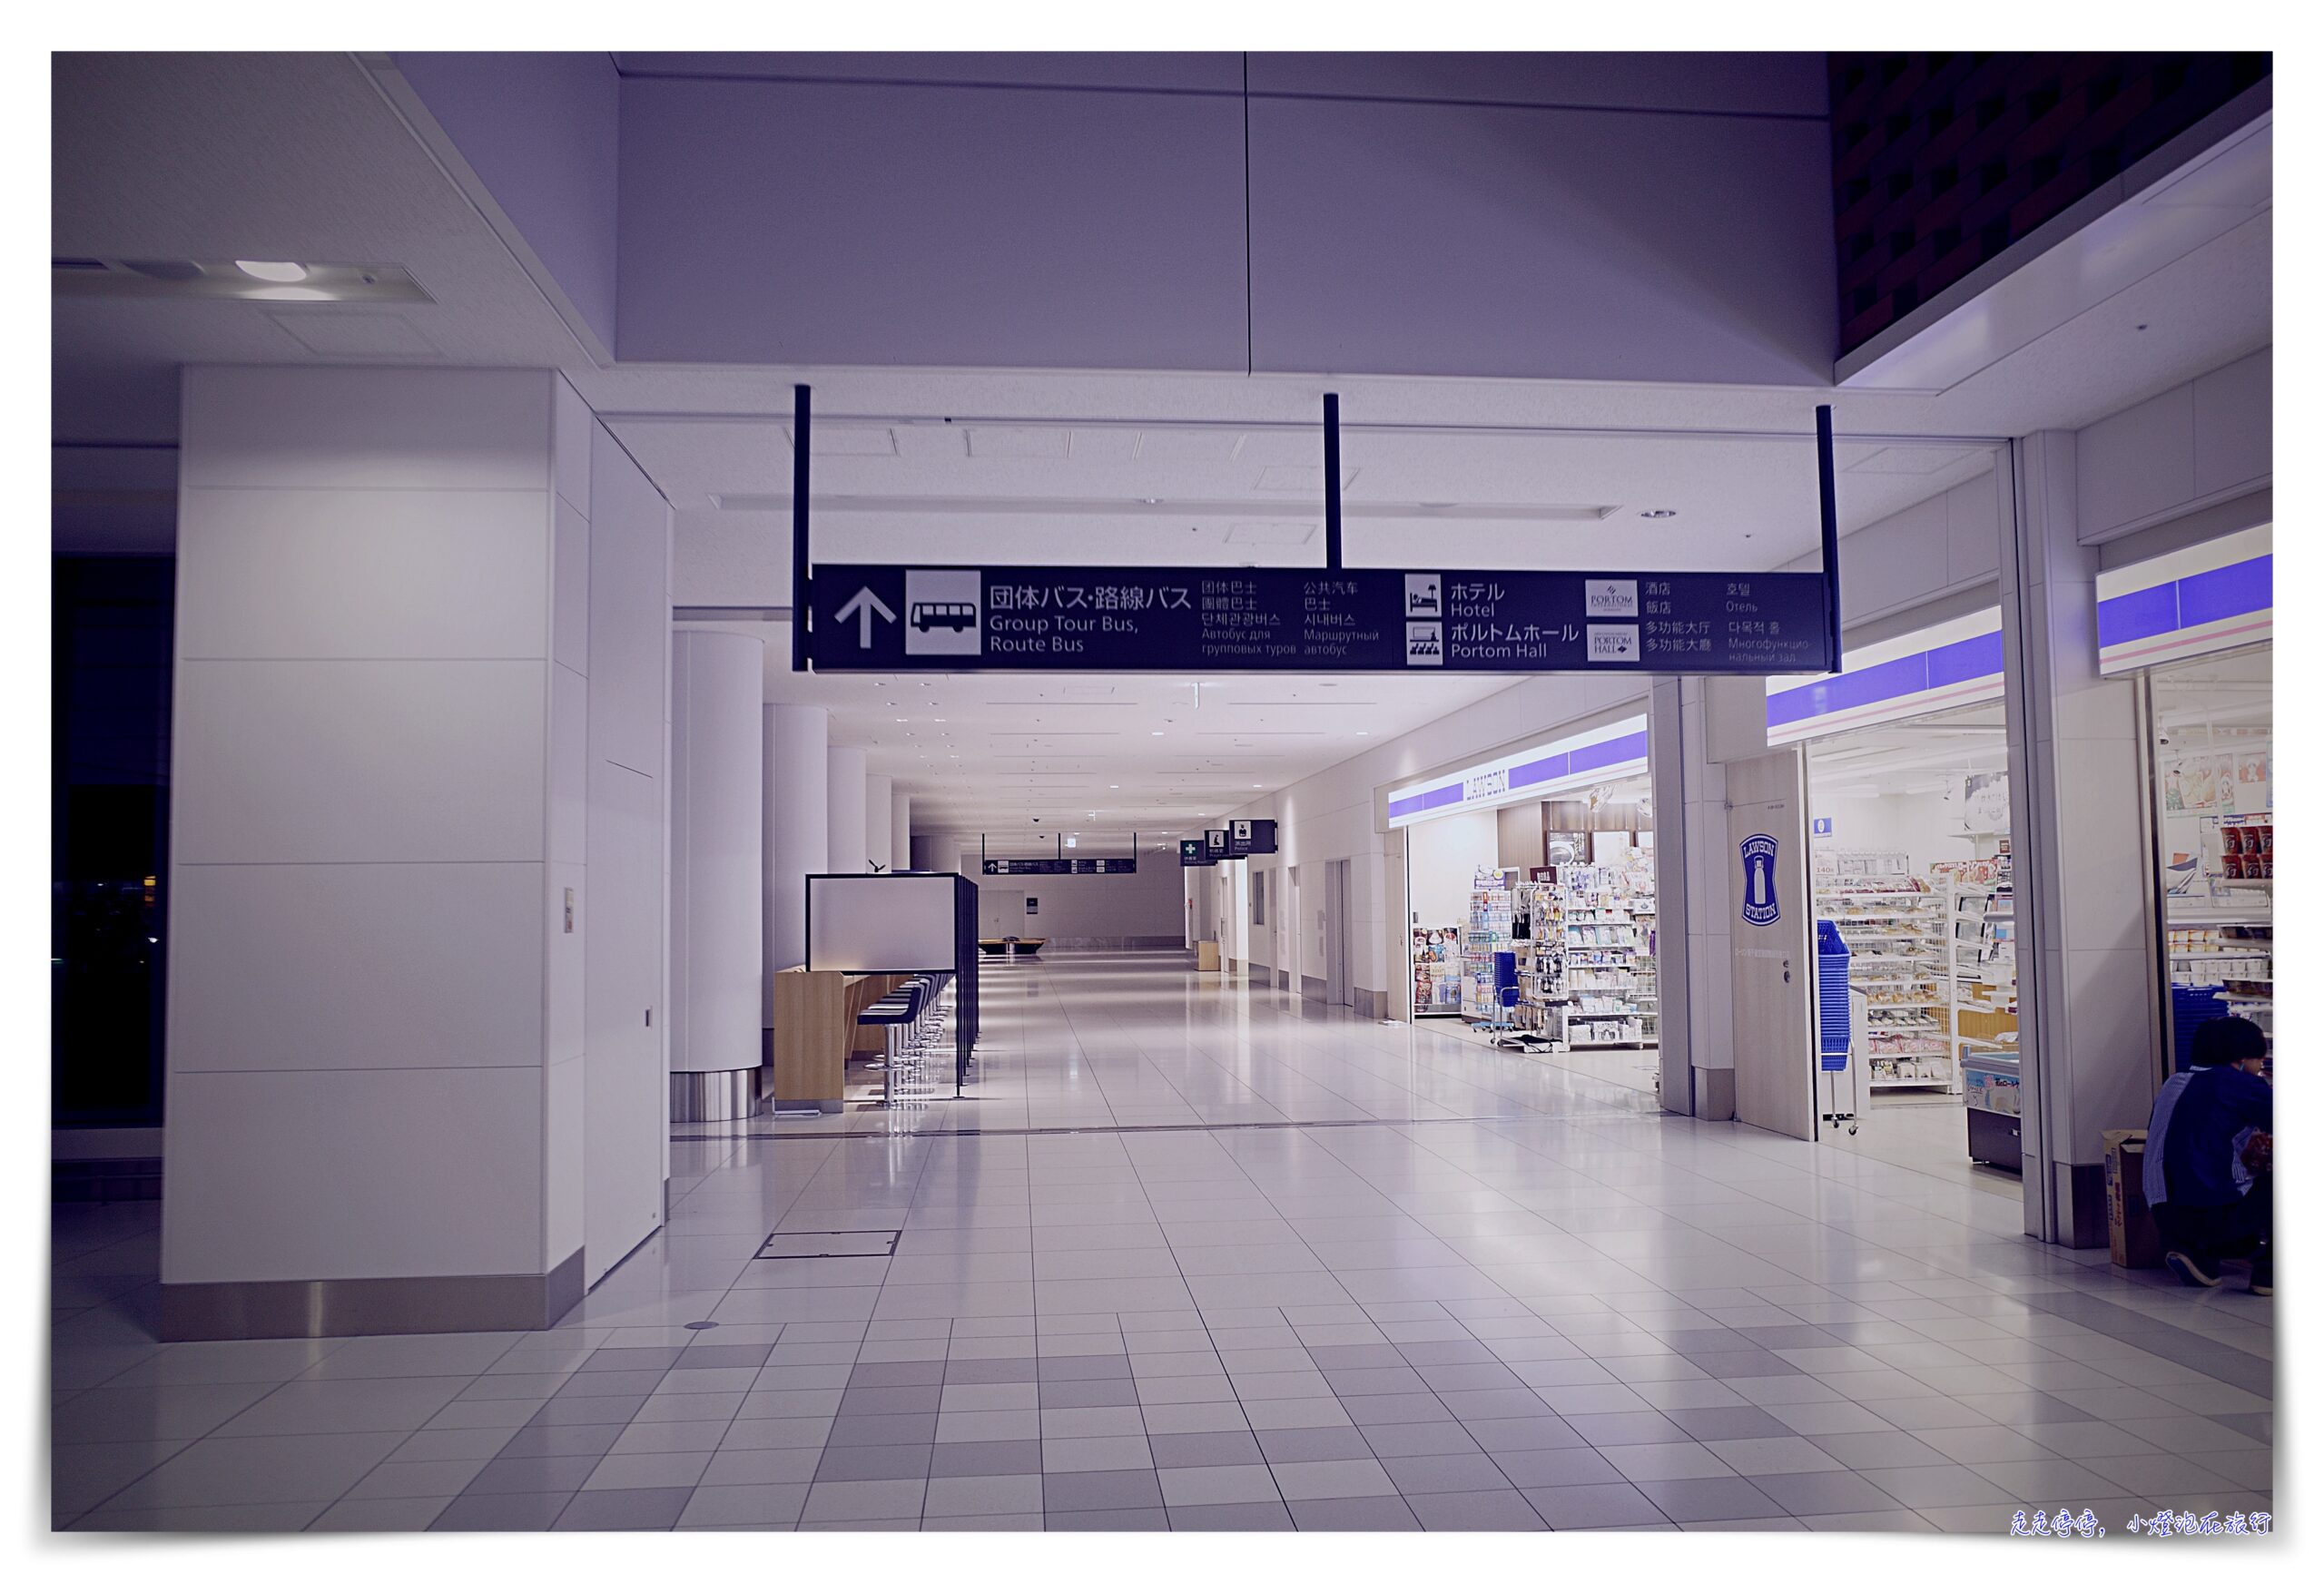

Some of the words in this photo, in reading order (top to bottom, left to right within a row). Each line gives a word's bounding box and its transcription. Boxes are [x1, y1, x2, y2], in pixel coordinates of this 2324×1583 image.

[1303, 581, 1359, 595] 公共汽车
[1451, 583, 1505, 603] ホテル
[1645, 581, 1671, 596] 酒店
[1726, 583, 1751, 597] 호텔
[990, 585, 1192, 611] 団体バス・路線バス
[1304, 596, 1332, 611] 巴士
[1590, 595, 1633, 604] PORTOM
[1451, 603, 1495, 618] Hotel
[1645, 601, 1671, 615] 飯店
[1726, 600, 1758, 613] Отель
[990, 615, 1049, 635] Group
[1054, 615, 1097, 632] Tour
[1101, 615, 1139, 634] Bus,
[1201, 613, 1282, 627] 단체관광버스
[1304, 613, 1356, 627] 시내버스
[1645, 620, 1711, 635] 多功能大厅
[1201, 627, 1247, 643] Автобус
[1249, 630, 1271, 641] для
[1451, 622, 1580, 643] ポルトムホール
[1728, 621, 1765, 635] 다목적
[1768, 621, 1781, 635] 홀
[990, 635, 1046, 652] Route
[1052, 635, 1084, 652] Bus
[1304, 628, 1380, 644] Маршрутный
[1594, 636, 1632, 644] PORTOM
[1201, 644, 1263, 657] групповых
[1265, 644, 1297, 657] туров
[1304, 643, 1347, 658] автобус
[1451, 644, 1512, 659] Portom
[1516, 644, 1548, 659] Hall
[1594, 645, 1617, 654] HALL
[1777, 653, 1797, 663] зал
[1466, 769, 1506, 801] LAWSON
[1743, 840, 1776, 859] LAWSON
[1745, 902, 1777, 920] STATION
